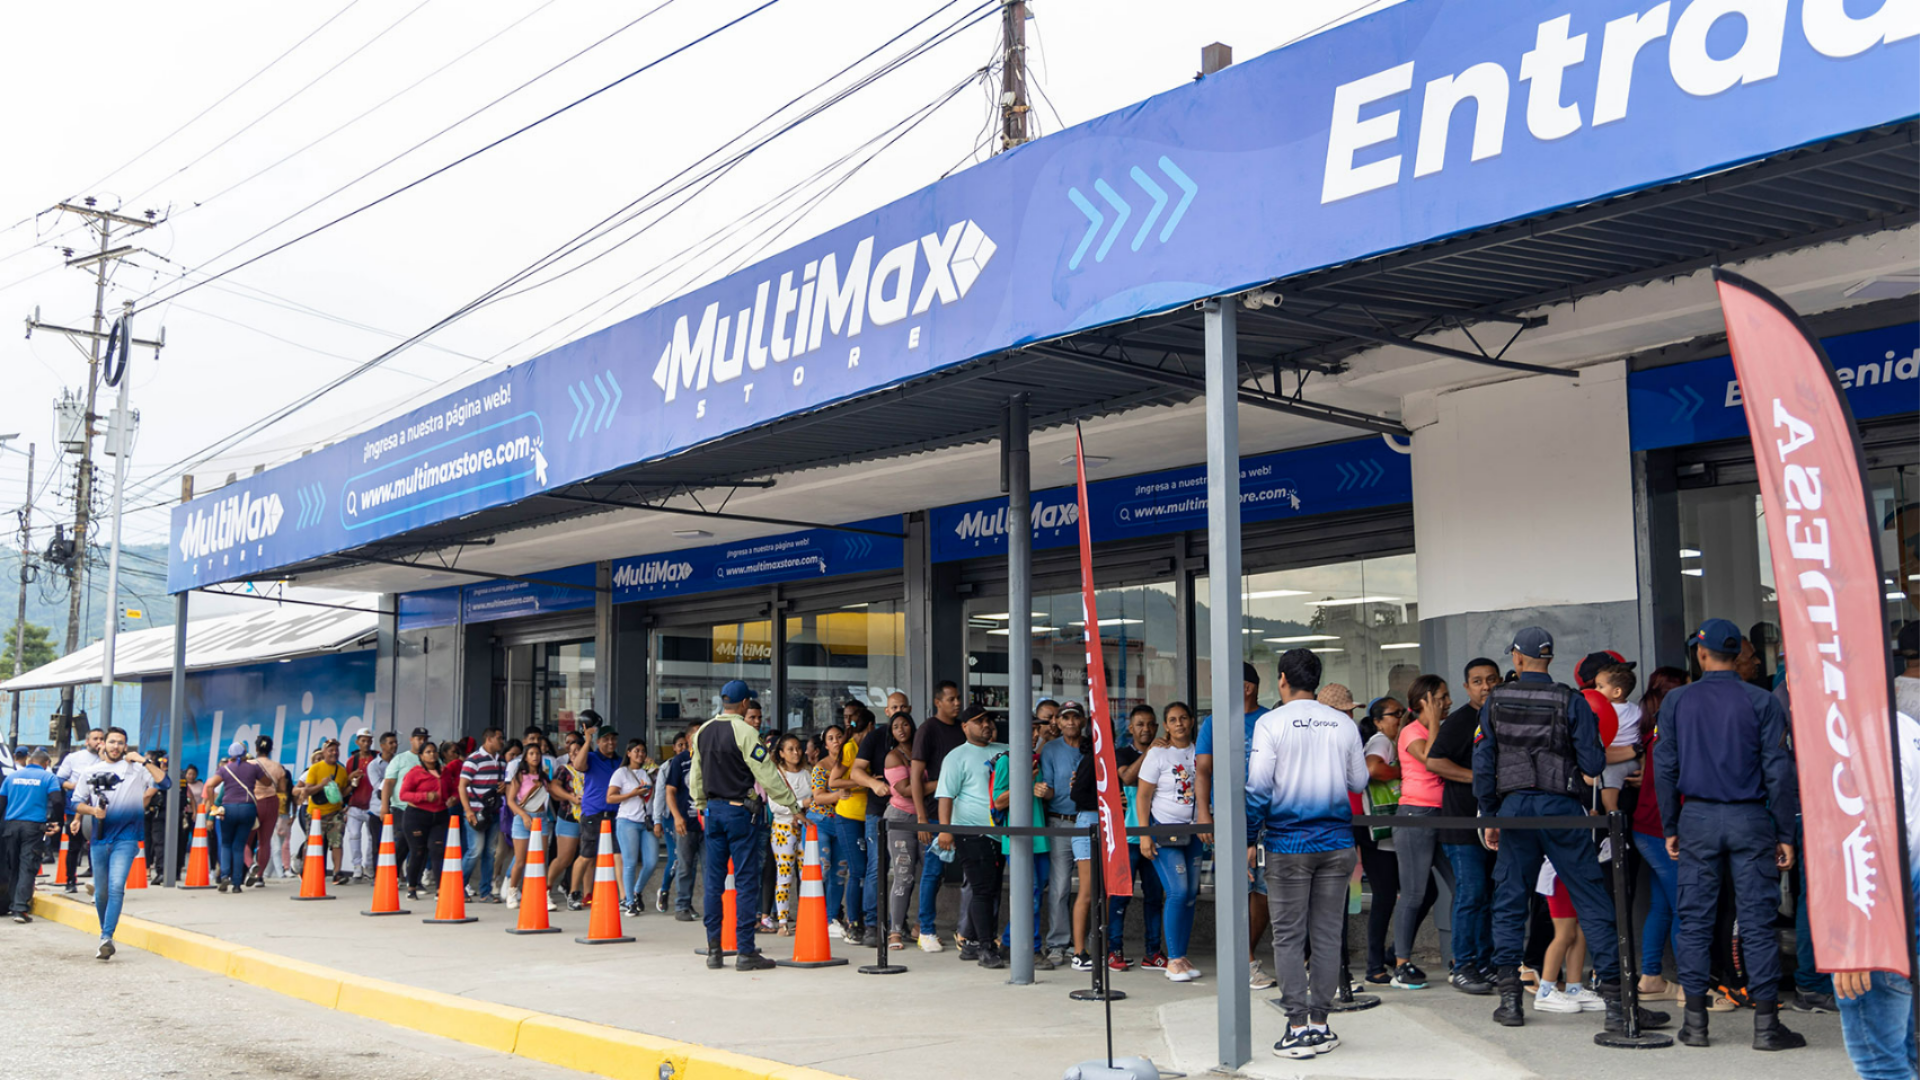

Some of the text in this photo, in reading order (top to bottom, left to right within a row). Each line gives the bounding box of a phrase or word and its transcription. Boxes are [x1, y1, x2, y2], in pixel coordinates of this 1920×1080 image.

[664, 220, 967, 403] MultiMax
[696, 326, 920, 418] STORE
[400, 430, 406, 445] a
[407, 414, 443, 443] nuestra
[445, 398, 481, 432] página
[483, 383, 511, 412] web!
[361, 435, 530, 510] www.multimaxstore.com
[1135, 481, 1170, 496] ¡Ingresa
[1178, 476, 1208, 488] nuestr
[1248, 465, 1272, 478] web!
[961, 501, 1073, 540] MulMax
[1134, 487, 1286, 519] www.multimre.com
[183, 490, 276, 562] MultiMax
[975, 529, 1060, 547] STRE
[616, 560, 683, 588] MultiMax
[726, 556, 818, 576] www.multimaxstore.com
[718, 642, 771, 658] MultiMa
[271, 691, 375, 786] Lind
